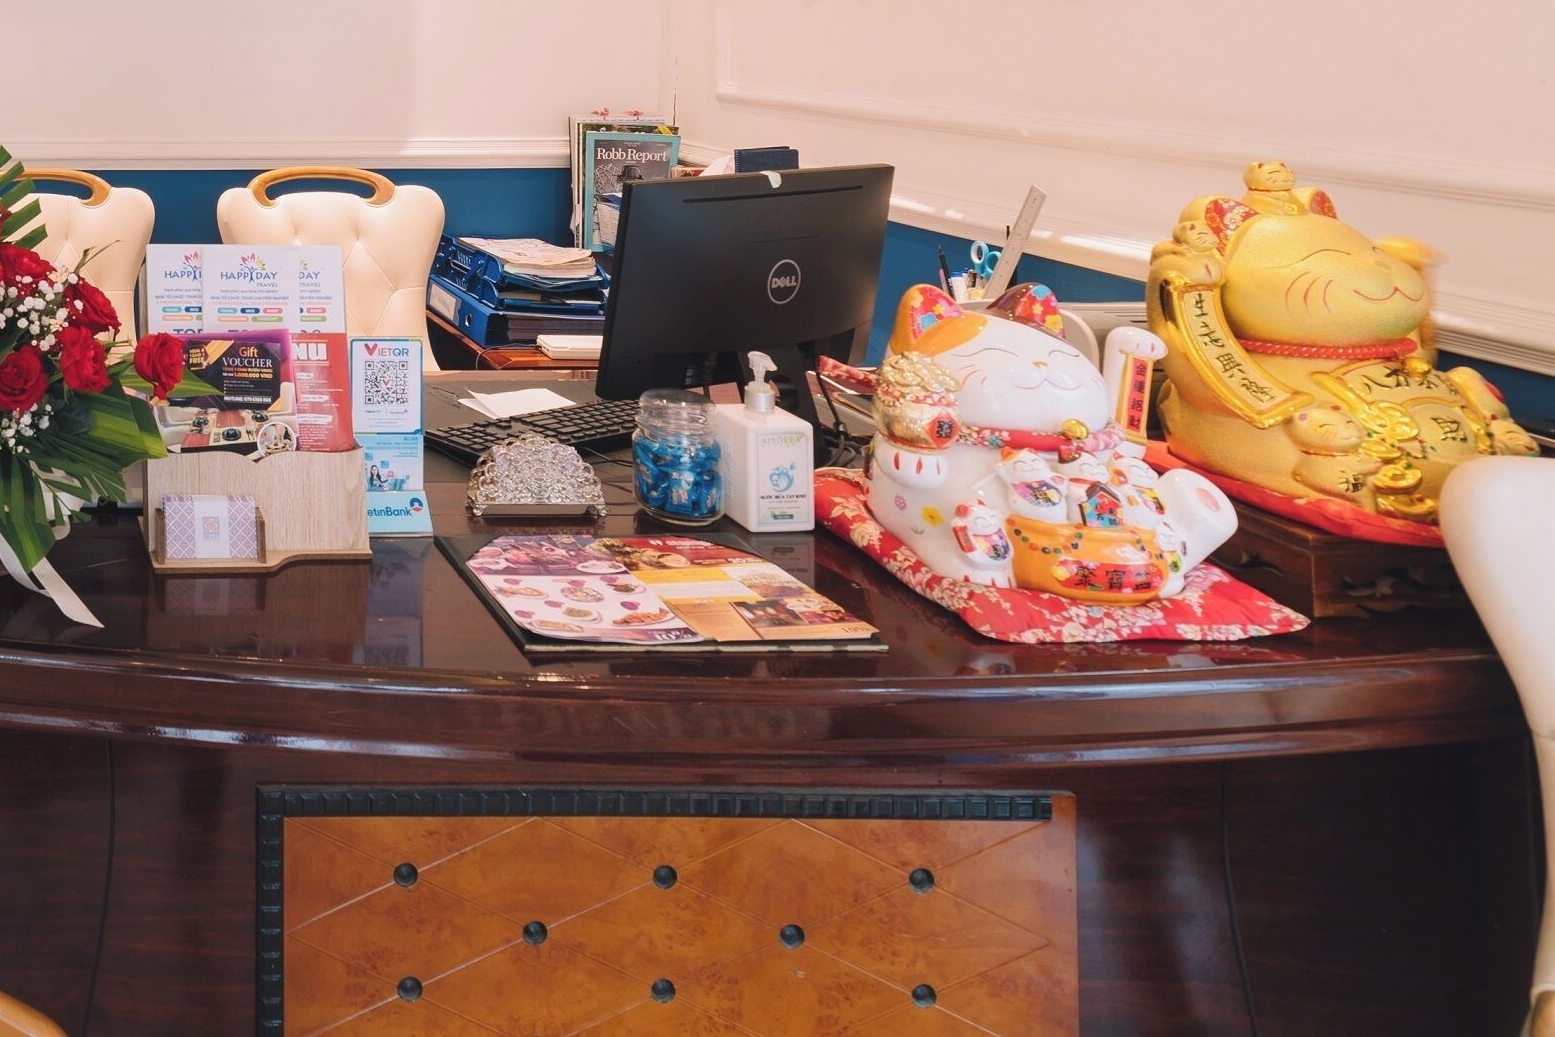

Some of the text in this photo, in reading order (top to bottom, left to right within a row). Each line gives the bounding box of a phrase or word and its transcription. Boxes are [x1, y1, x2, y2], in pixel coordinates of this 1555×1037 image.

[596, 148, 668, 163] Robb Report
[771, 276, 797, 289] DELL
[239, 346, 258, 358] Gift
[293, 343, 327, 360] NU
[364, 343, 410, 357] VIETQR
[223, 358, 273, 368] VOUCHER
[367, 506, 412, 516] etinBank
